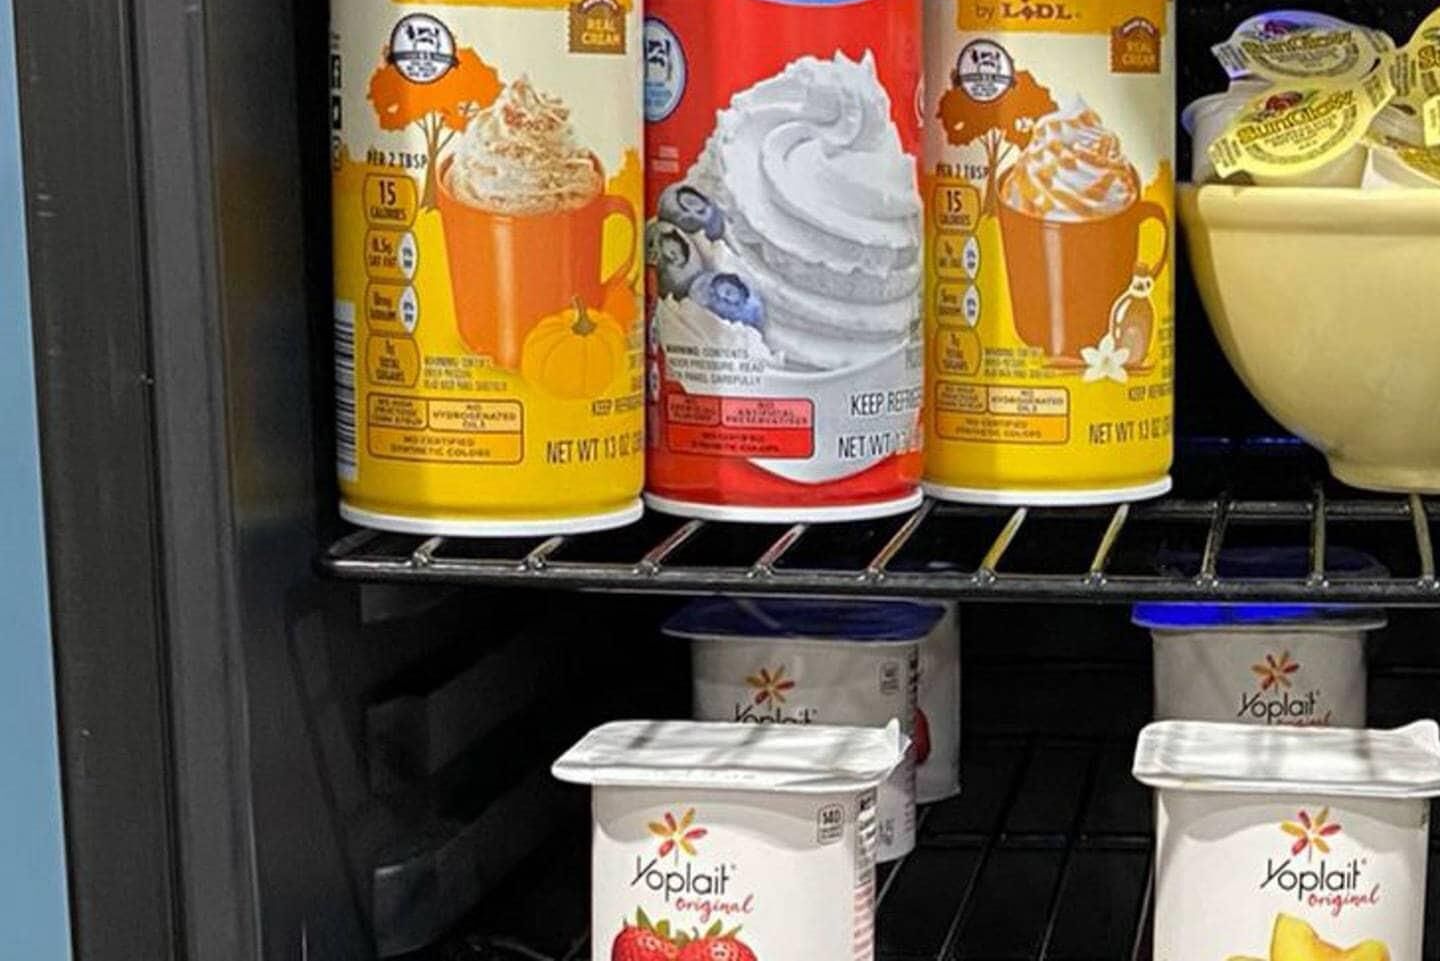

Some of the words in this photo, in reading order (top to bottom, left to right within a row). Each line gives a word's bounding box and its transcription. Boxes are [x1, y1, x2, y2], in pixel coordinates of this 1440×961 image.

[975, 3, 995, 21] by
[1236, 89, 1356, 145] SunGlow
[366, 149, 385, 166] PER
[388, 153, 396, 167] 2
[400, 152, 428, 169] TBSP
[379, 179, 397, 206] 15
[946, 190, 963, 213] 15
[850, 391, 885, 417] KEEP
[838, 435, 865, 459] NET
[868, 432, 891, 456] WT
[1088, 422, 1113, 444] NET
[1115, 420, 1135, 443] WT
[546, 439, 573, 464] NET
[577, 437, 599, 462] WT
[604, 434, 616, 459] 13
[1237, 691, 1316, 727] Yoplait
[630, 854, 731, 901] Yoplait
[1260, 858, 1361, 901] Yoplait
[675, 893, 755, 924] original
[1307, 884, 1381, 918] original
